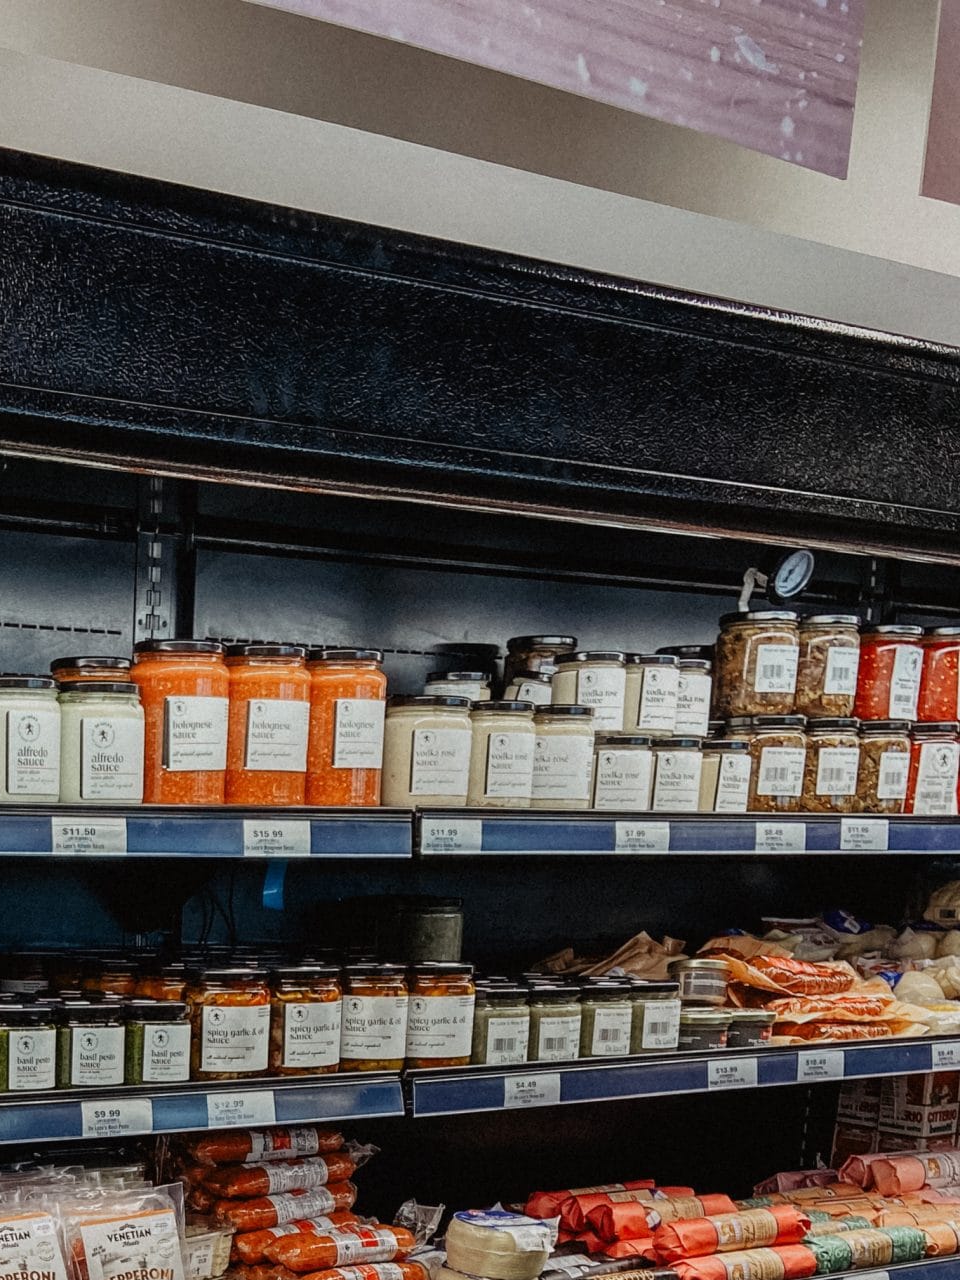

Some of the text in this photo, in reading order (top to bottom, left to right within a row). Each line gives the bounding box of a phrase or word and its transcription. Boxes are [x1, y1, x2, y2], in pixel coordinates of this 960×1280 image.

[172, 720, 212, 732] bolognese
[252, 721, 290, 732] bolognese
[340, 721, 374, 732] bolognese
[172, 730, 196, 739] sauce
[17, 746, 48, 757] alfredo
[17, 756, 44, 766] sauce
[91, 752, 124, 764] alfredo
[91, 762, 120, 772] sauce
[62, 828, 96, 836] $11.50
[253, 830, 283, 838] $15.99
[345, 1018, 366, 1028] spicy
[368, 1017, 388, 1026] garlic
[410, 1017, 429, 1027] spicy
[431, 1016, 450, 1026] garlic
[290, 1026, 310, 1036] spicy
[312, 1024, 330, 1036] garlic
[345, 1025, 367, 1033] sauce
[409, 1024, 430, 1032] sauce
[207, 1029, 228, 1040] spicy
[230, 1028, 252, 1038] garlic
[80, 1052, 98, 1062] basil
[151, 1049, 168, 1058] basil
[16, 1056, 34, 1065] basil
[80, 1060, 100, 1068] sauce
[151, 1056, 172, 1065] sauce
[16, 1064, 38, 1072] sauce
[516, 1081, 536, 1089] $4.49
[94, 1110, 120, 1118] $9.99
[928, 1109, 957, 1122] CITTERIO
[107, 1228, 152, 1242] VENETIAN
